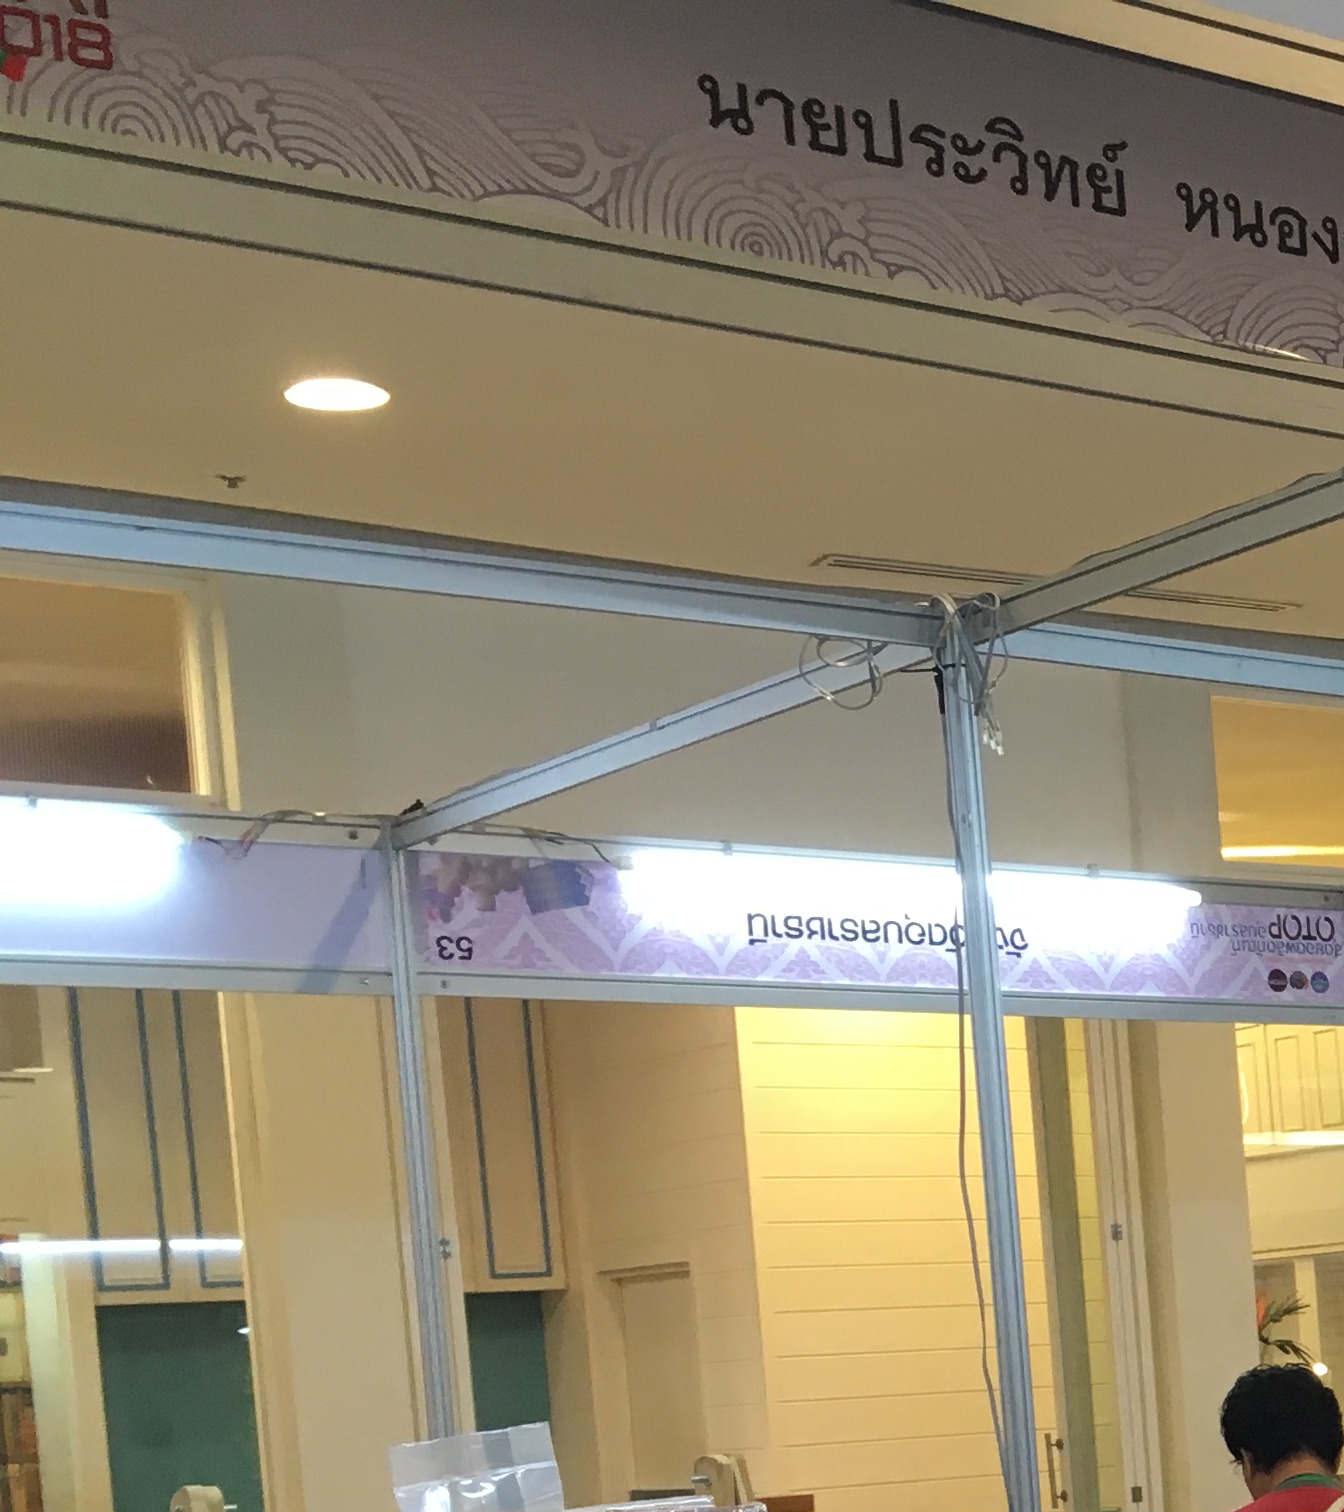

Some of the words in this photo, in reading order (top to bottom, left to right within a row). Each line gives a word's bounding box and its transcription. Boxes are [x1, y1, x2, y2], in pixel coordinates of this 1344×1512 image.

[697, 73, 1129, 217] นายประวิทย์
[747, 911, 1029, 959] จังวัดอุบลราชธานี
[1190, 920, 1267, 939] อุบลราชธานี
[1268, 914, 1336, 942] OTOP
[436, 935, 473, 960] 53
